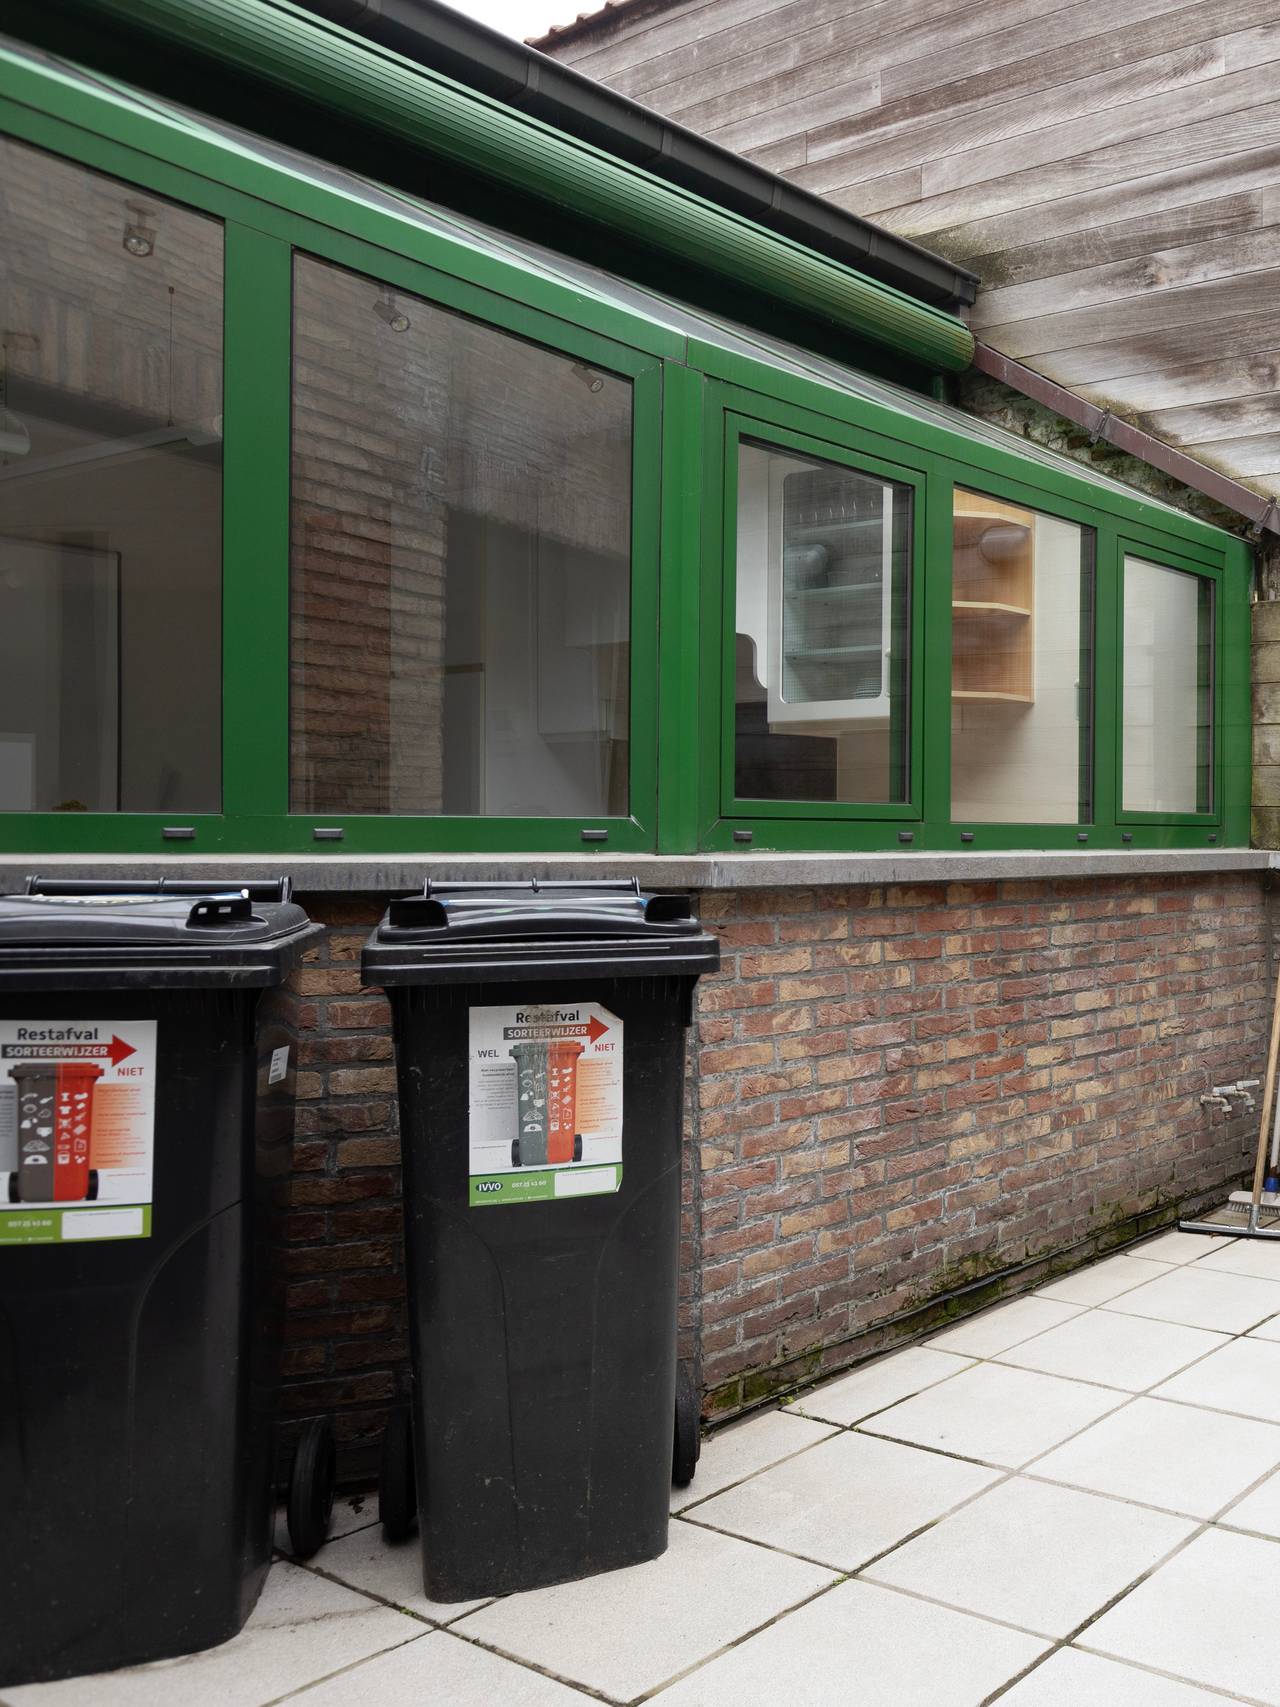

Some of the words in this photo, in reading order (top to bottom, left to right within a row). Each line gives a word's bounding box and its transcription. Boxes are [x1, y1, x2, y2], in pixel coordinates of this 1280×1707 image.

[516, 1010, 580, 1023] Restafval
[17, 1027, 99, 1041] Restafval
[507, 1026, 587, 1039] SORTEERWIJZER
[6, 1046, 108, 1058] SORTEERWIJZER
[594, 1043, 615, 1052] NIET
[477, 1050, 499, 1058] WEL
[117, 1067, 144, 1077] NIET
[478, 1182, 502, 1192] IVVO
